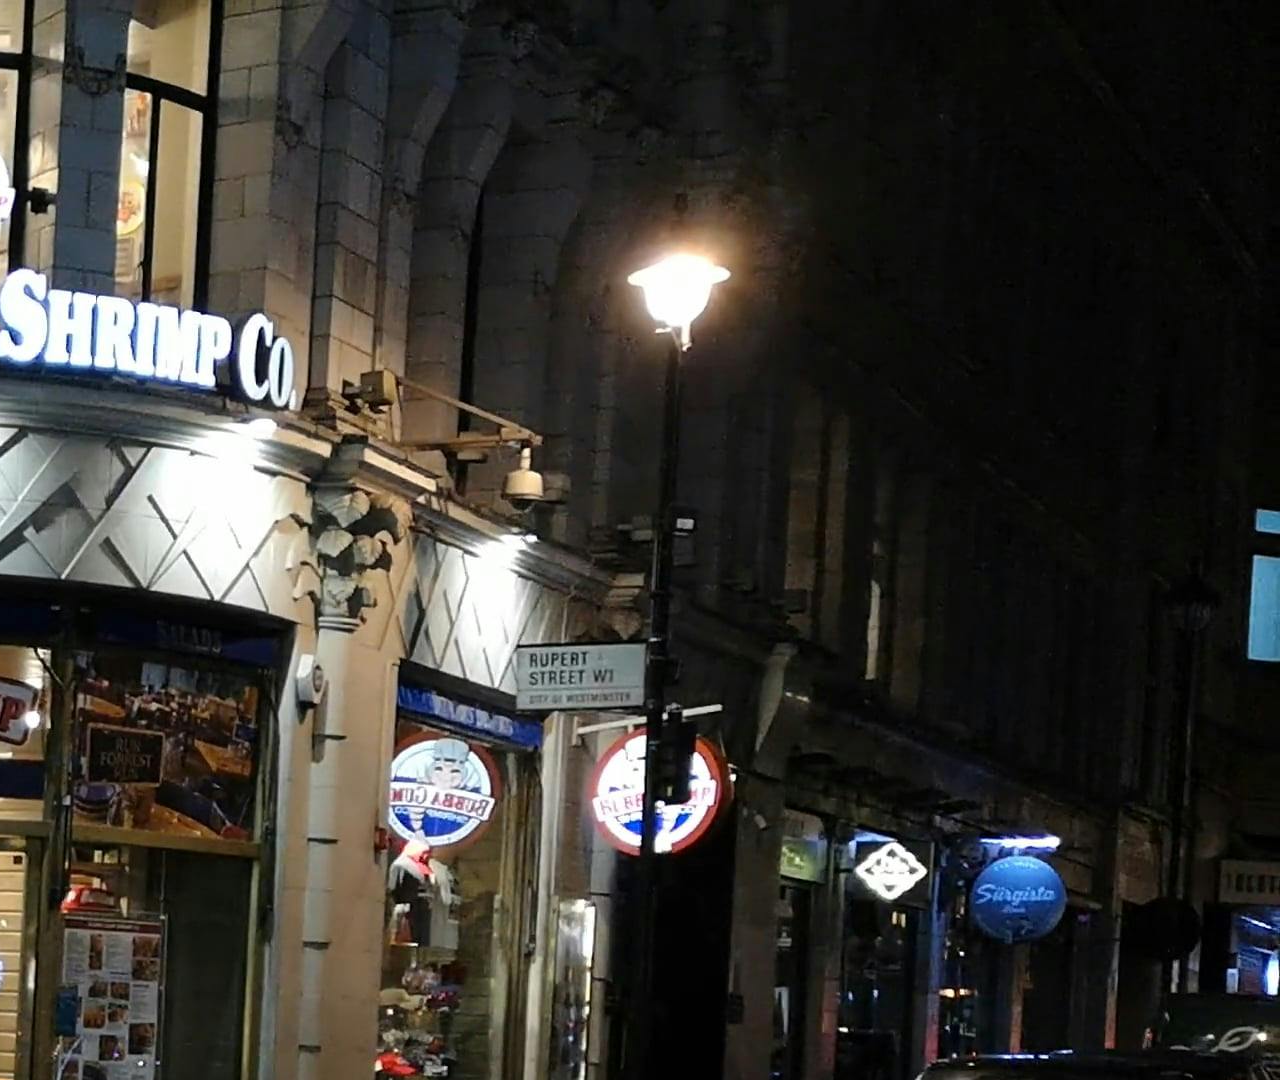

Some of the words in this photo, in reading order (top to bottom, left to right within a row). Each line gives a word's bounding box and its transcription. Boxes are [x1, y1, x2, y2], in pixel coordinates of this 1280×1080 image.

[239, 313, 301, 410] CO.
[529, 651, 589, 668] RUPERT
[529, 670, 585, 686] STREET
[593, 669, 614, 683] W1
[566, 692, 631, 704] WESTMINSTER
[975, 883, 1057, 906] Sürgista
